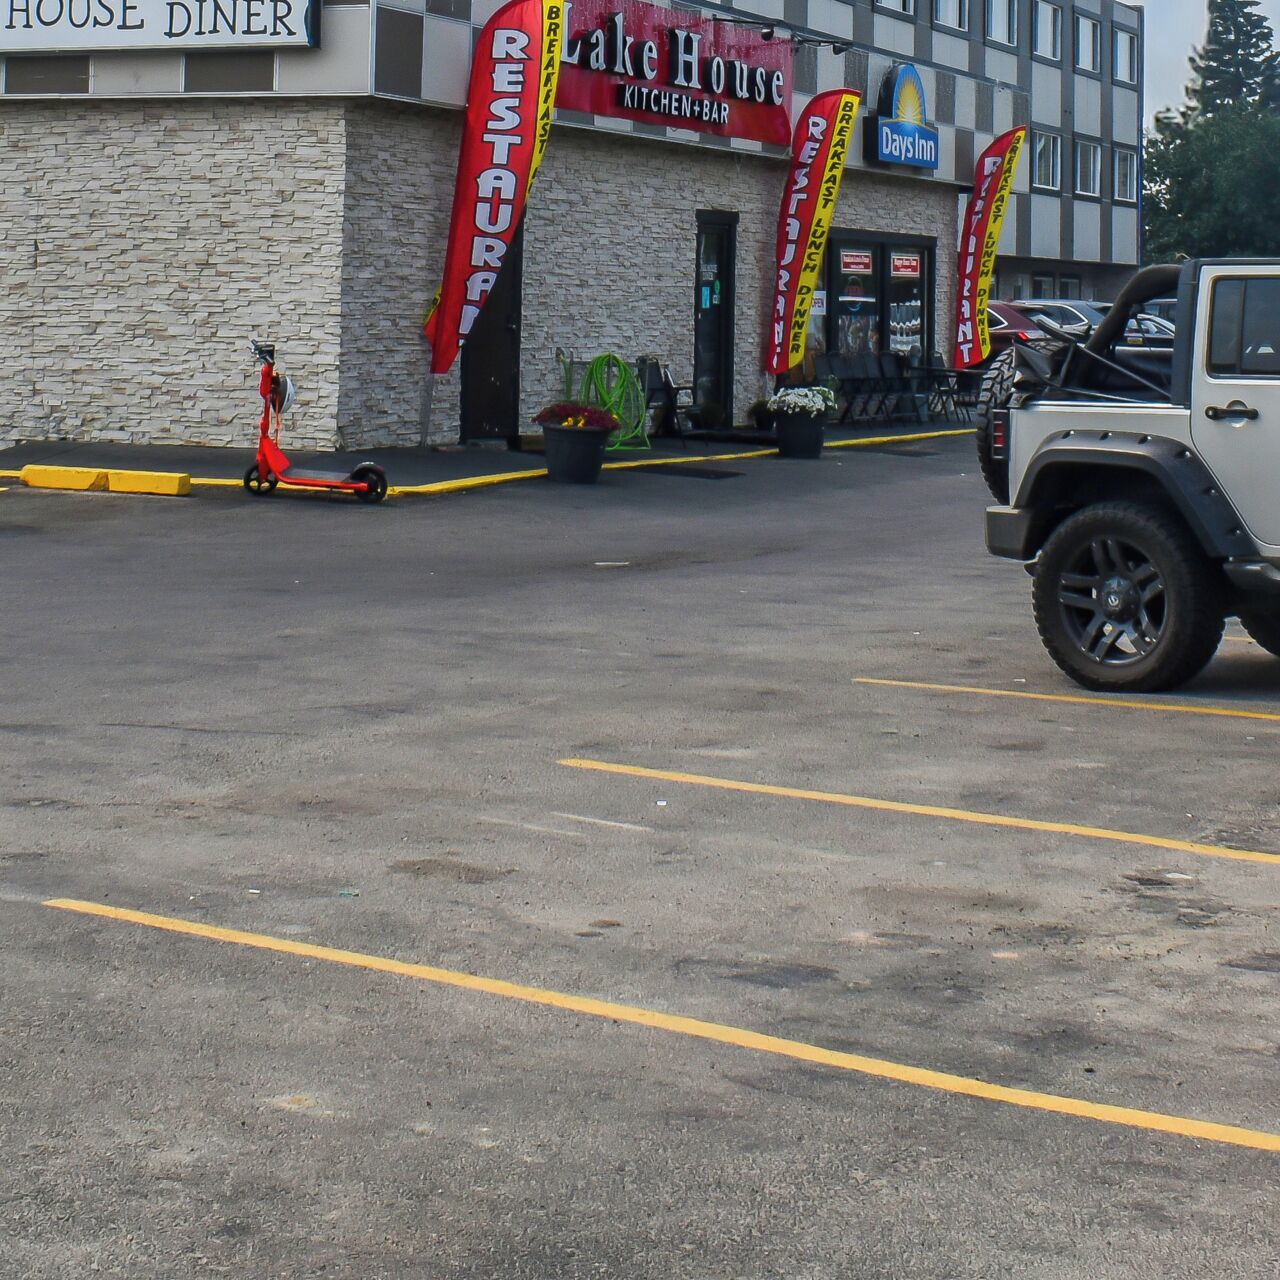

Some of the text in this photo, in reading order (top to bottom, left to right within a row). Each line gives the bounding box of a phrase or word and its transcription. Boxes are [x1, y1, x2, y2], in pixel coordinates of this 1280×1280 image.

[537, 6, 560, 154] BREAKFAST
[560, 2, 784, 106] Lake House
[624, 85, 729, 124] KITCHEN+BAR
[458, 29, 529, 346] RESTAURA
[882, 126, 935, 162] Days Inn
[790, 101, 854, 354] BREAKFAST LUNCH DINNER
[976, 135, 1022, 346] BREAKFAST LUNCH DINNER
